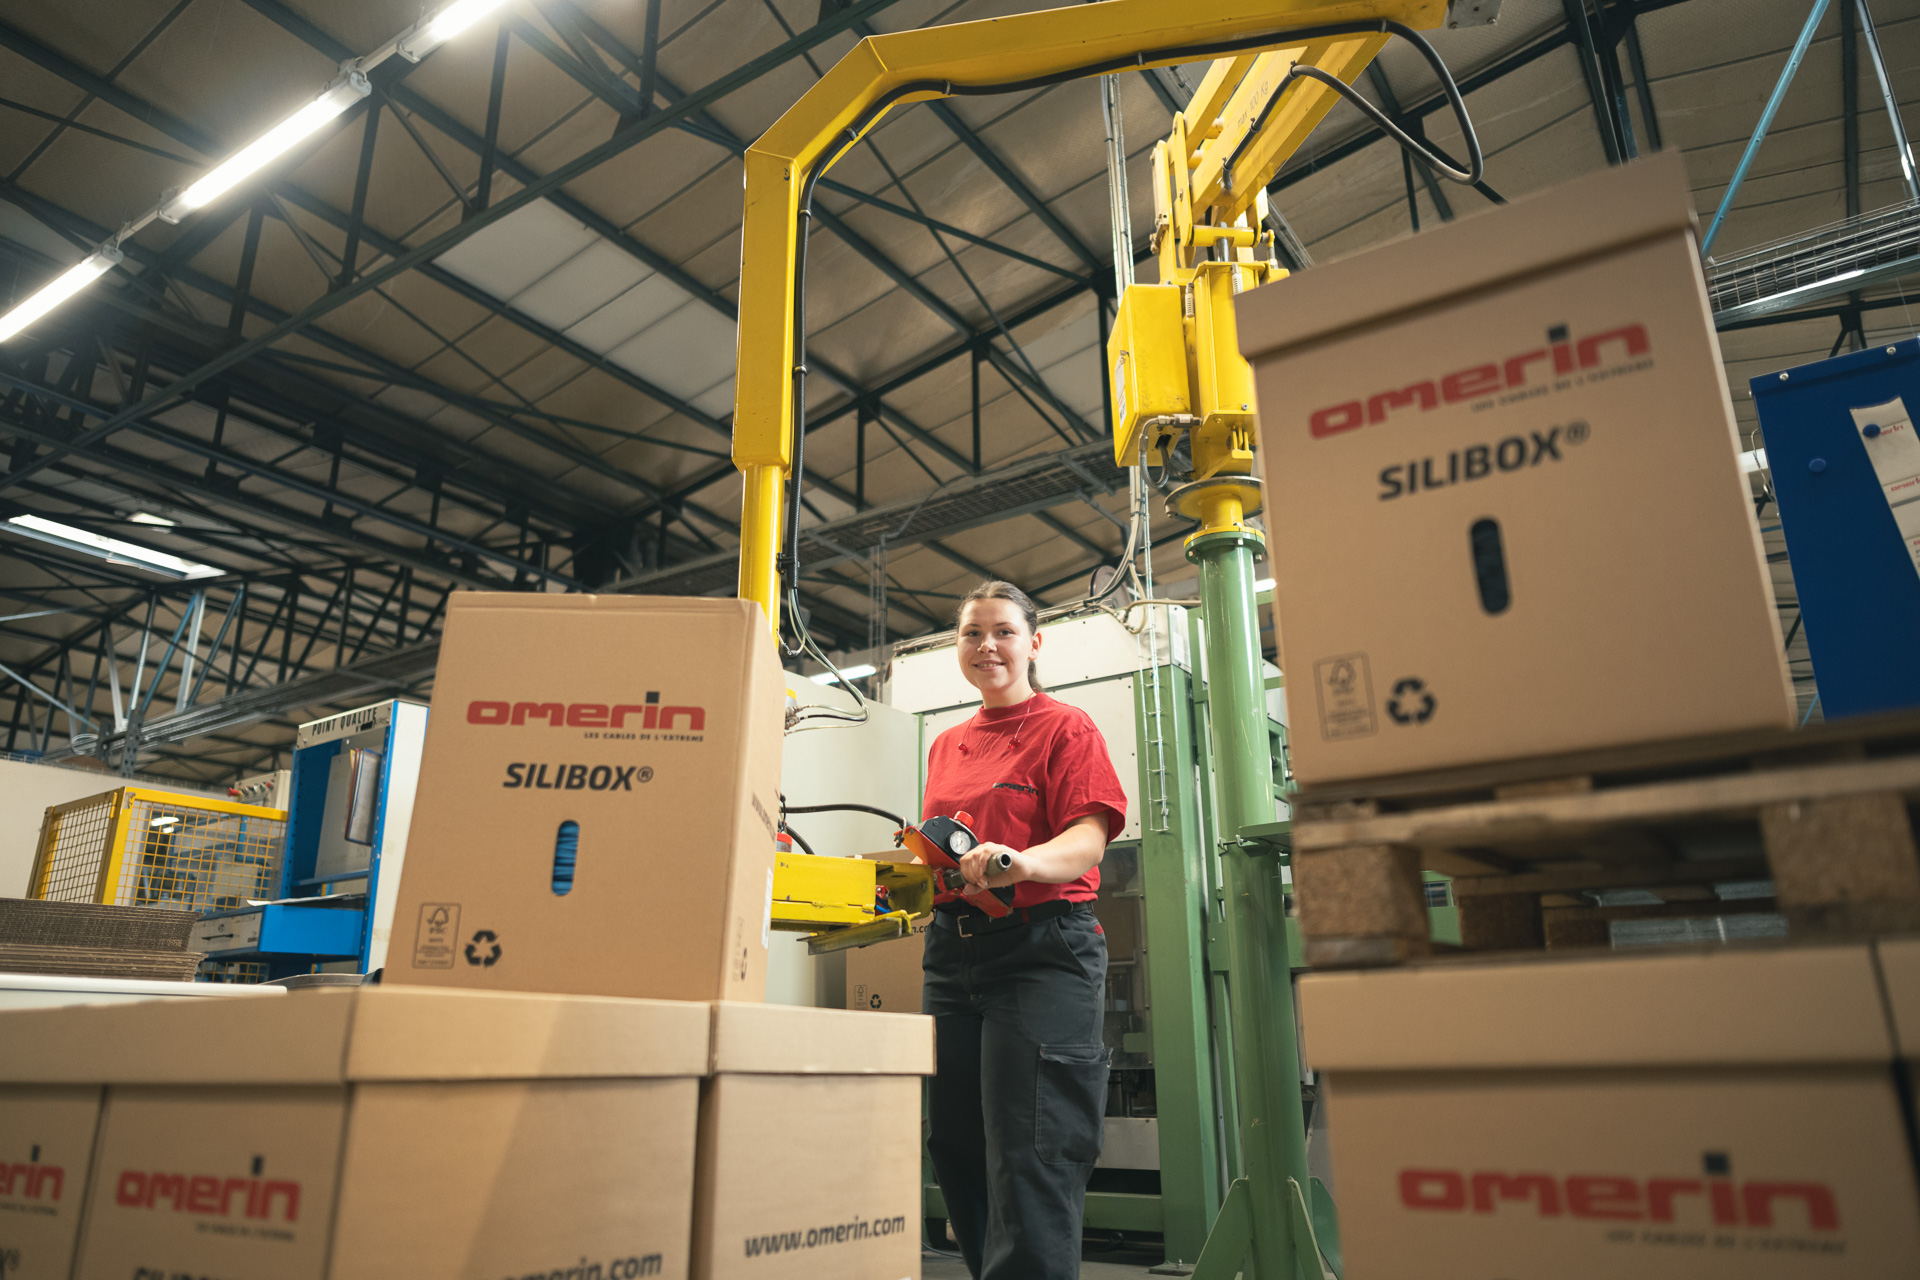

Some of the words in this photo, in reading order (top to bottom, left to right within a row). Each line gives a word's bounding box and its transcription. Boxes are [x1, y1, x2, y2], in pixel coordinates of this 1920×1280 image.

[1309, 322, 1651, 439] omerin
[312, 718, 336, 737] POINT
[466, 691, 706, 731] omerin
[992, 783, 1039, 796] omerin
[116, 1156, 301, 1222] omerin
[1398, 1151, 1840, 1231] omerin
[745, 1215, 905, 1258] www.omerin.com
